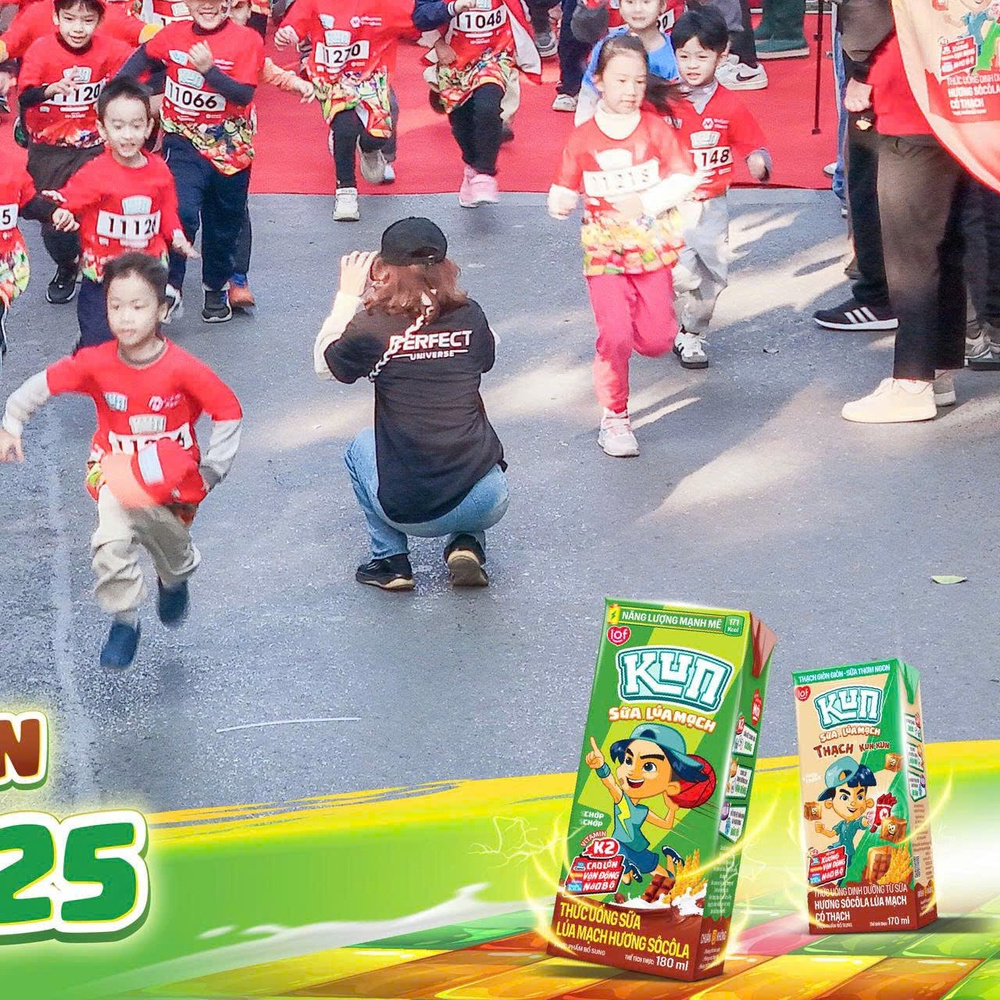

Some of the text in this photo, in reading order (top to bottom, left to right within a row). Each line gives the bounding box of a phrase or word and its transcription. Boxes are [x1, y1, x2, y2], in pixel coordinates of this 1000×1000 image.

[168, 82, 219, 109] 11066
[700, 148, 731, 168] 148
[388, 330, 473, 352] PERFECT
[409, 350, 456, 361] UNIVERSE
